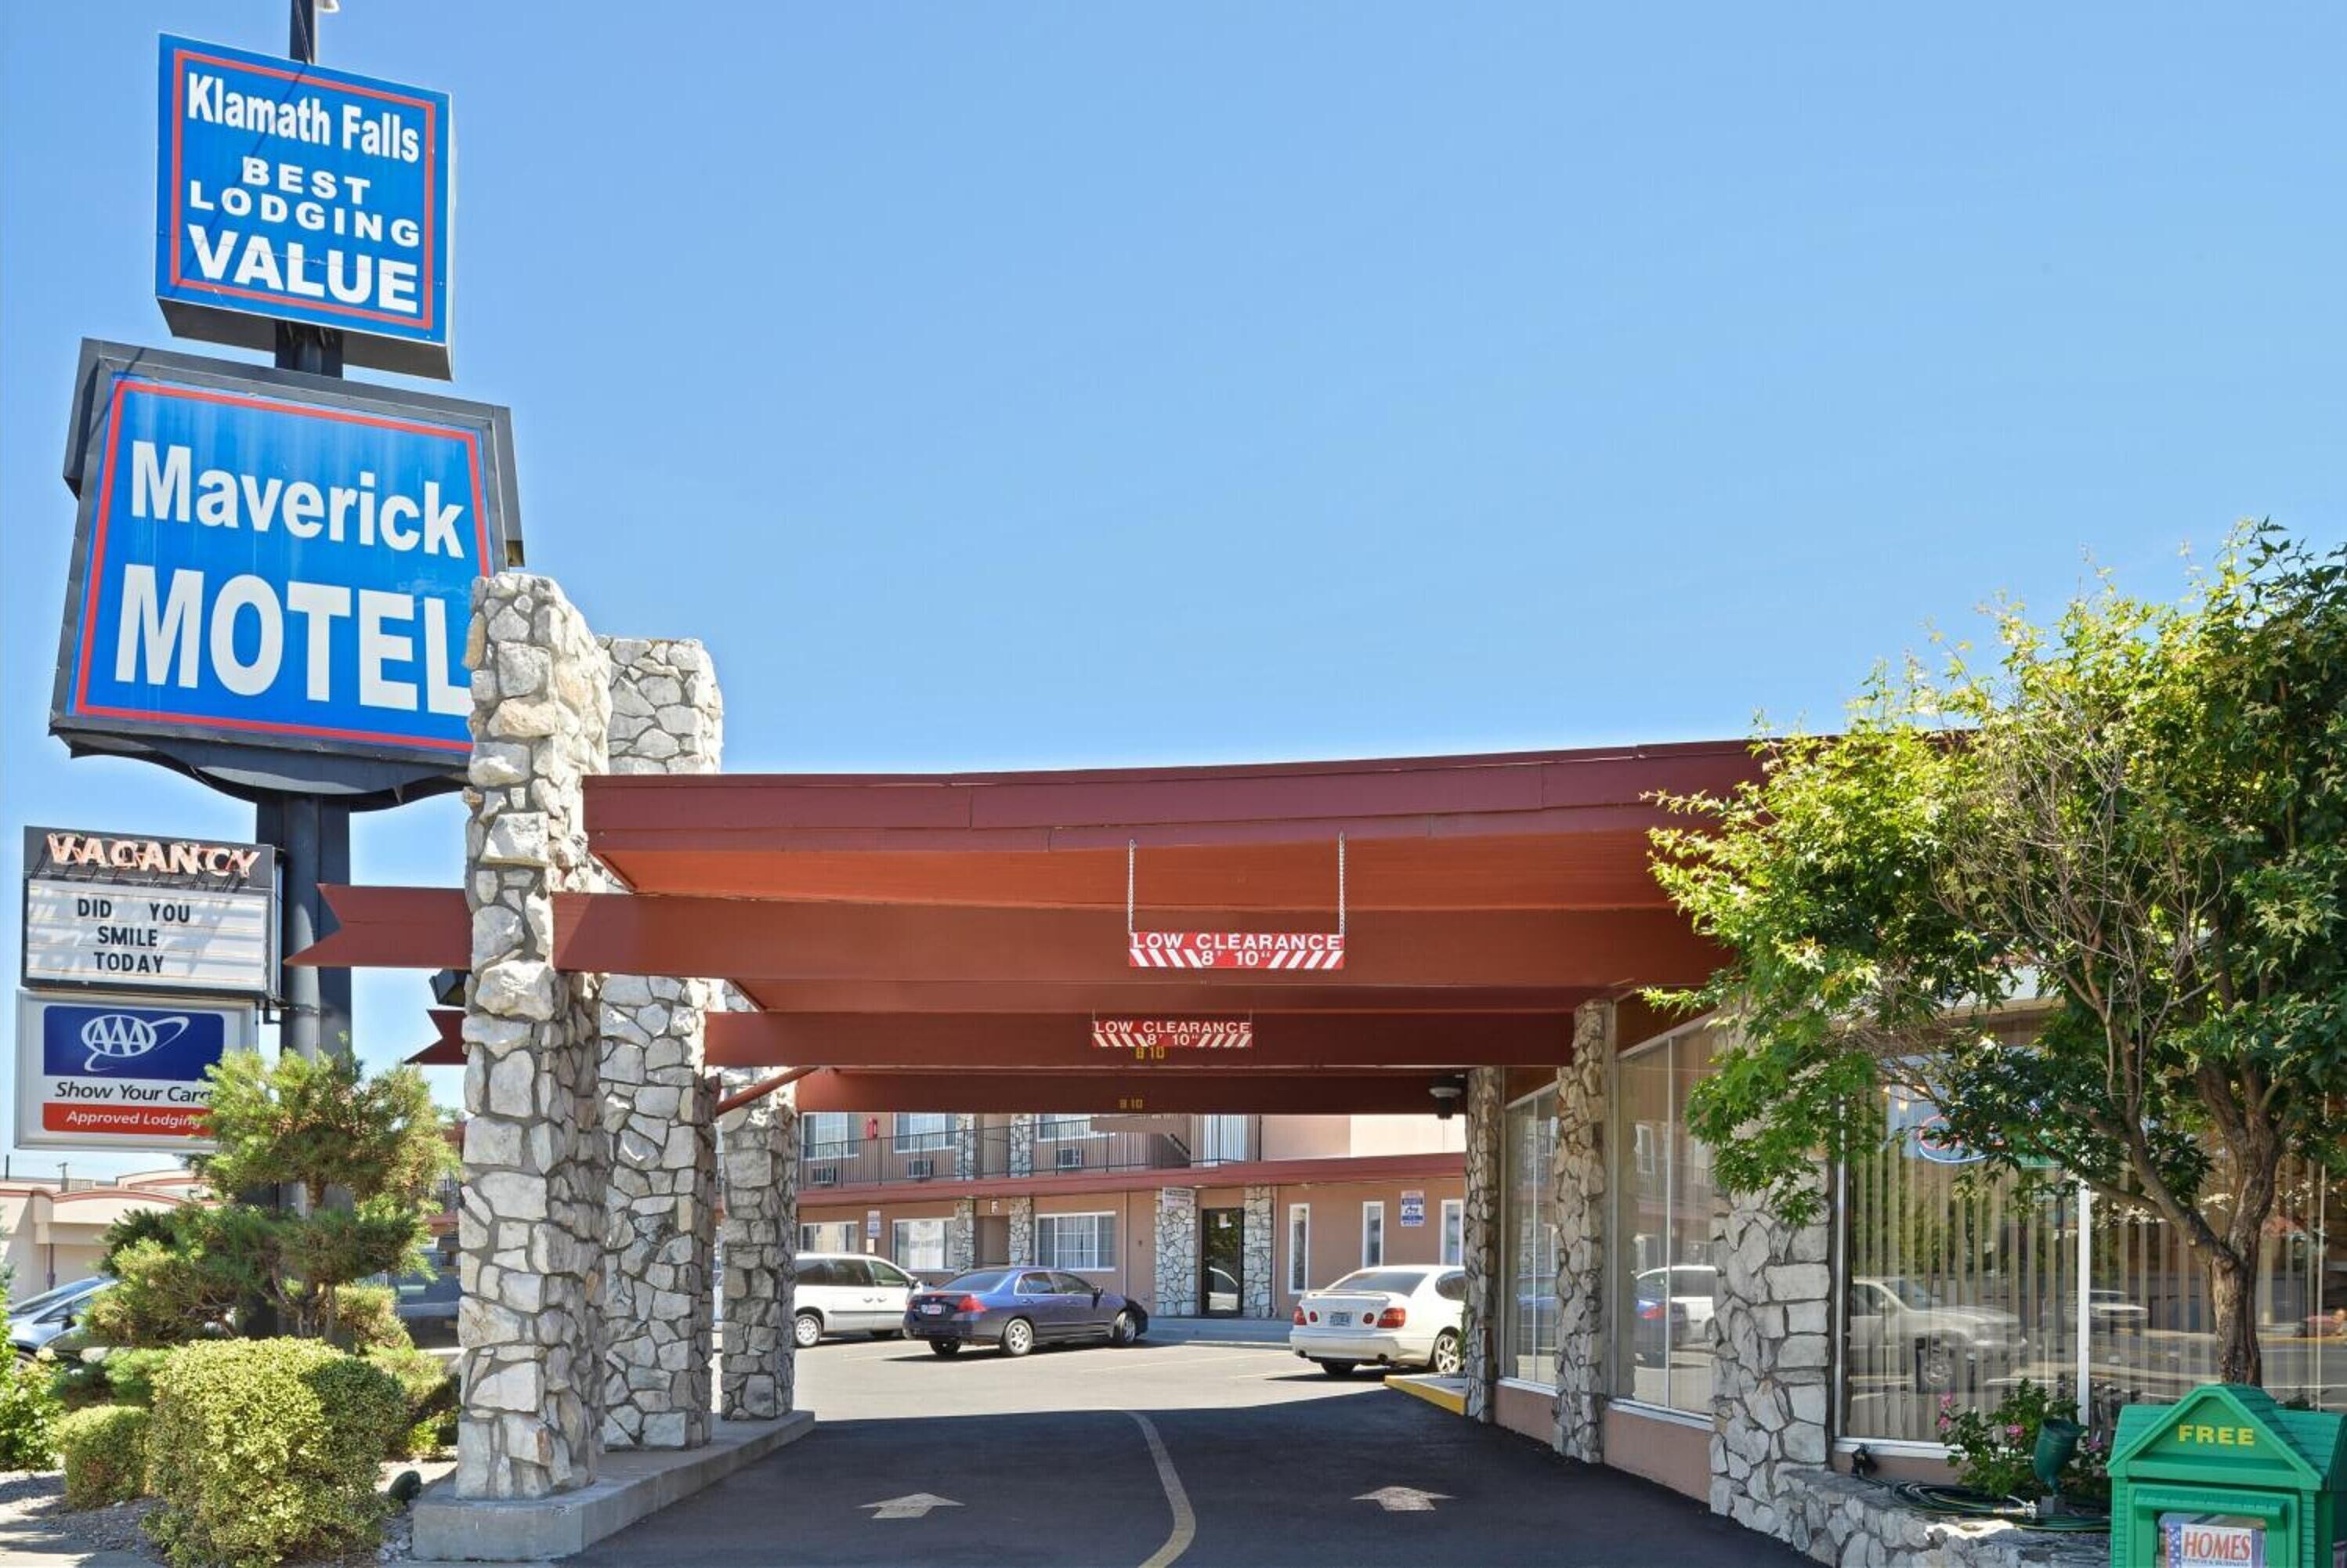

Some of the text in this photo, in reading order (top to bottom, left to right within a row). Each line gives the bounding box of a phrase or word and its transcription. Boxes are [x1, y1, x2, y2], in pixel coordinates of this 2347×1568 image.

[188, 72, 419, 163] Klamath Falls
[243, 156, 370, 204] BEST
[190, 179, 419, 247] LODGING
[187, 223, 418, 313] VALUE
[132, 440, 465, 558] Maverick
[115, 563, 473, 717] MOTEL
[48, 833, 260, 878] VACANCY
[78, 898, 190, 923] DID YOU
[98, 926, 157, 946] SMILE
[1133, 933, 1341, 950] LOW CLEARANCE
[94, 952, 164, 973] TODAY
[86, 1016, 152, 1055] AAA
[1094, 1021, 1251, 1034] LOW CLEARANCE
[55, 1081, 114, 1100] Show
[120, 1084, 163, 1101] Your
[66, 1110, 140, 1125] Approved
[2179, 1425, 2255, 1445] FREE
[2184, 1531, 2251, 1561] HOMES
